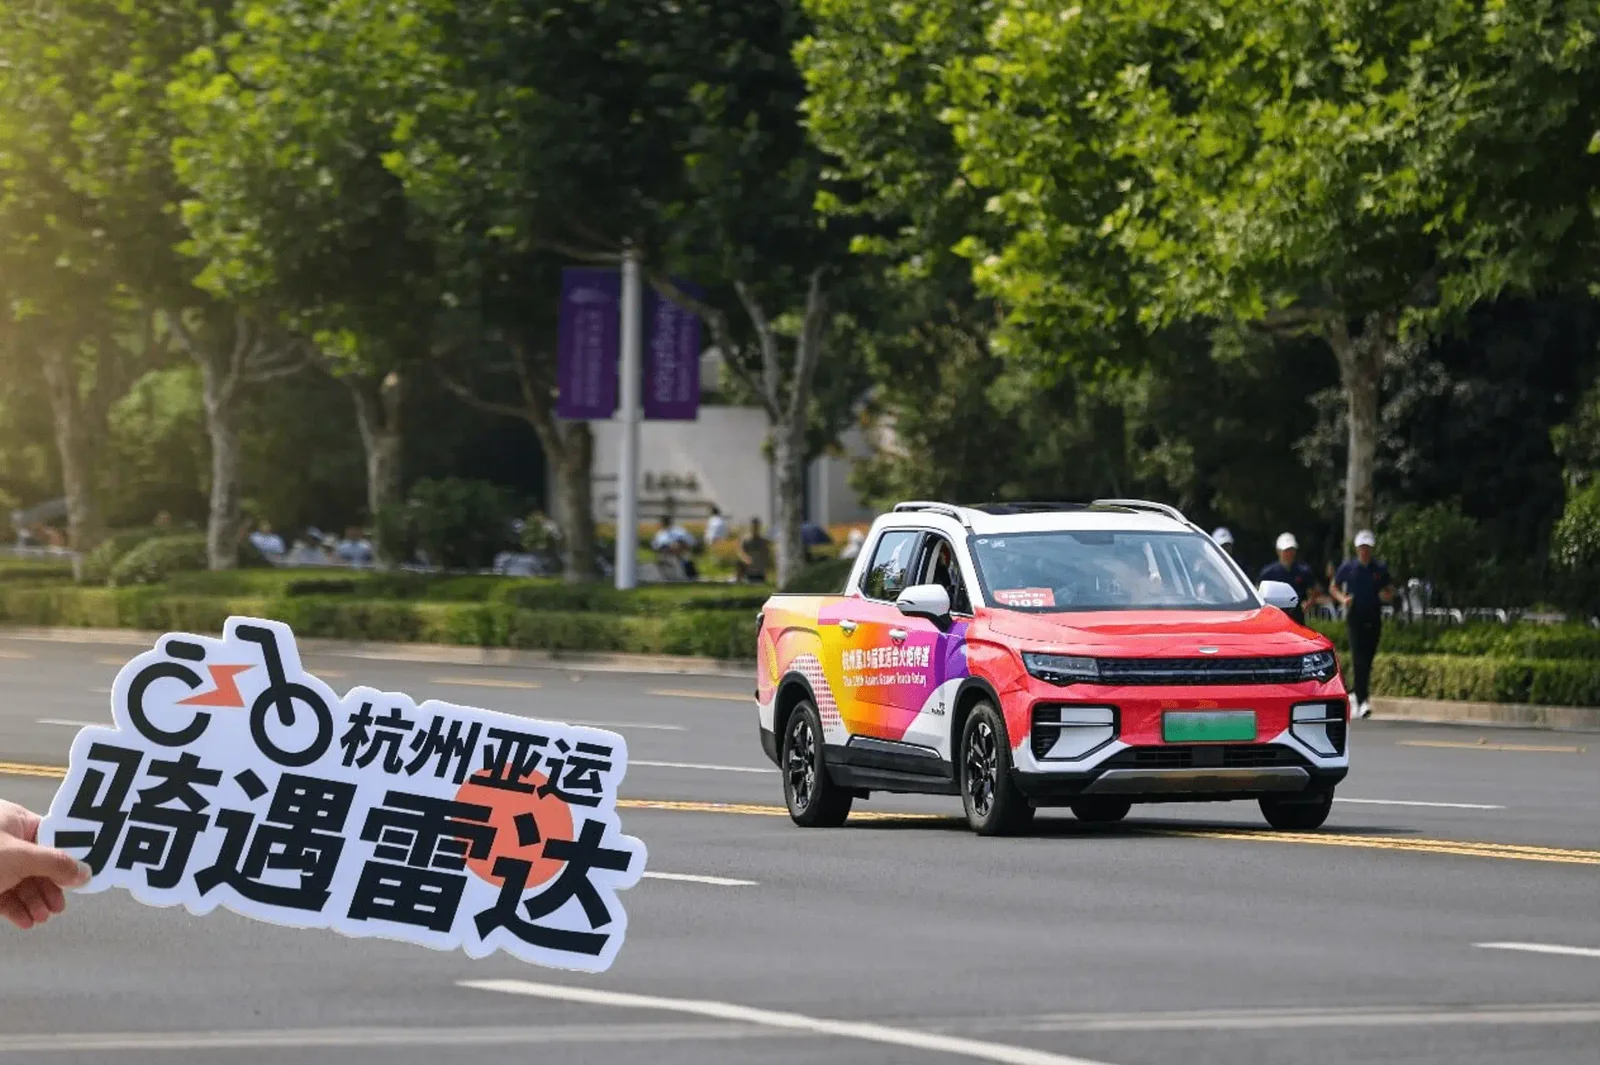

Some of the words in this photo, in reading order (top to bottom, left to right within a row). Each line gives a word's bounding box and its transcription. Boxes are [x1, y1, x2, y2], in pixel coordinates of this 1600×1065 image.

[340, 702, 613, 808] 杭州亚运
[55, 742, 632, 956] 骑遇雷达
